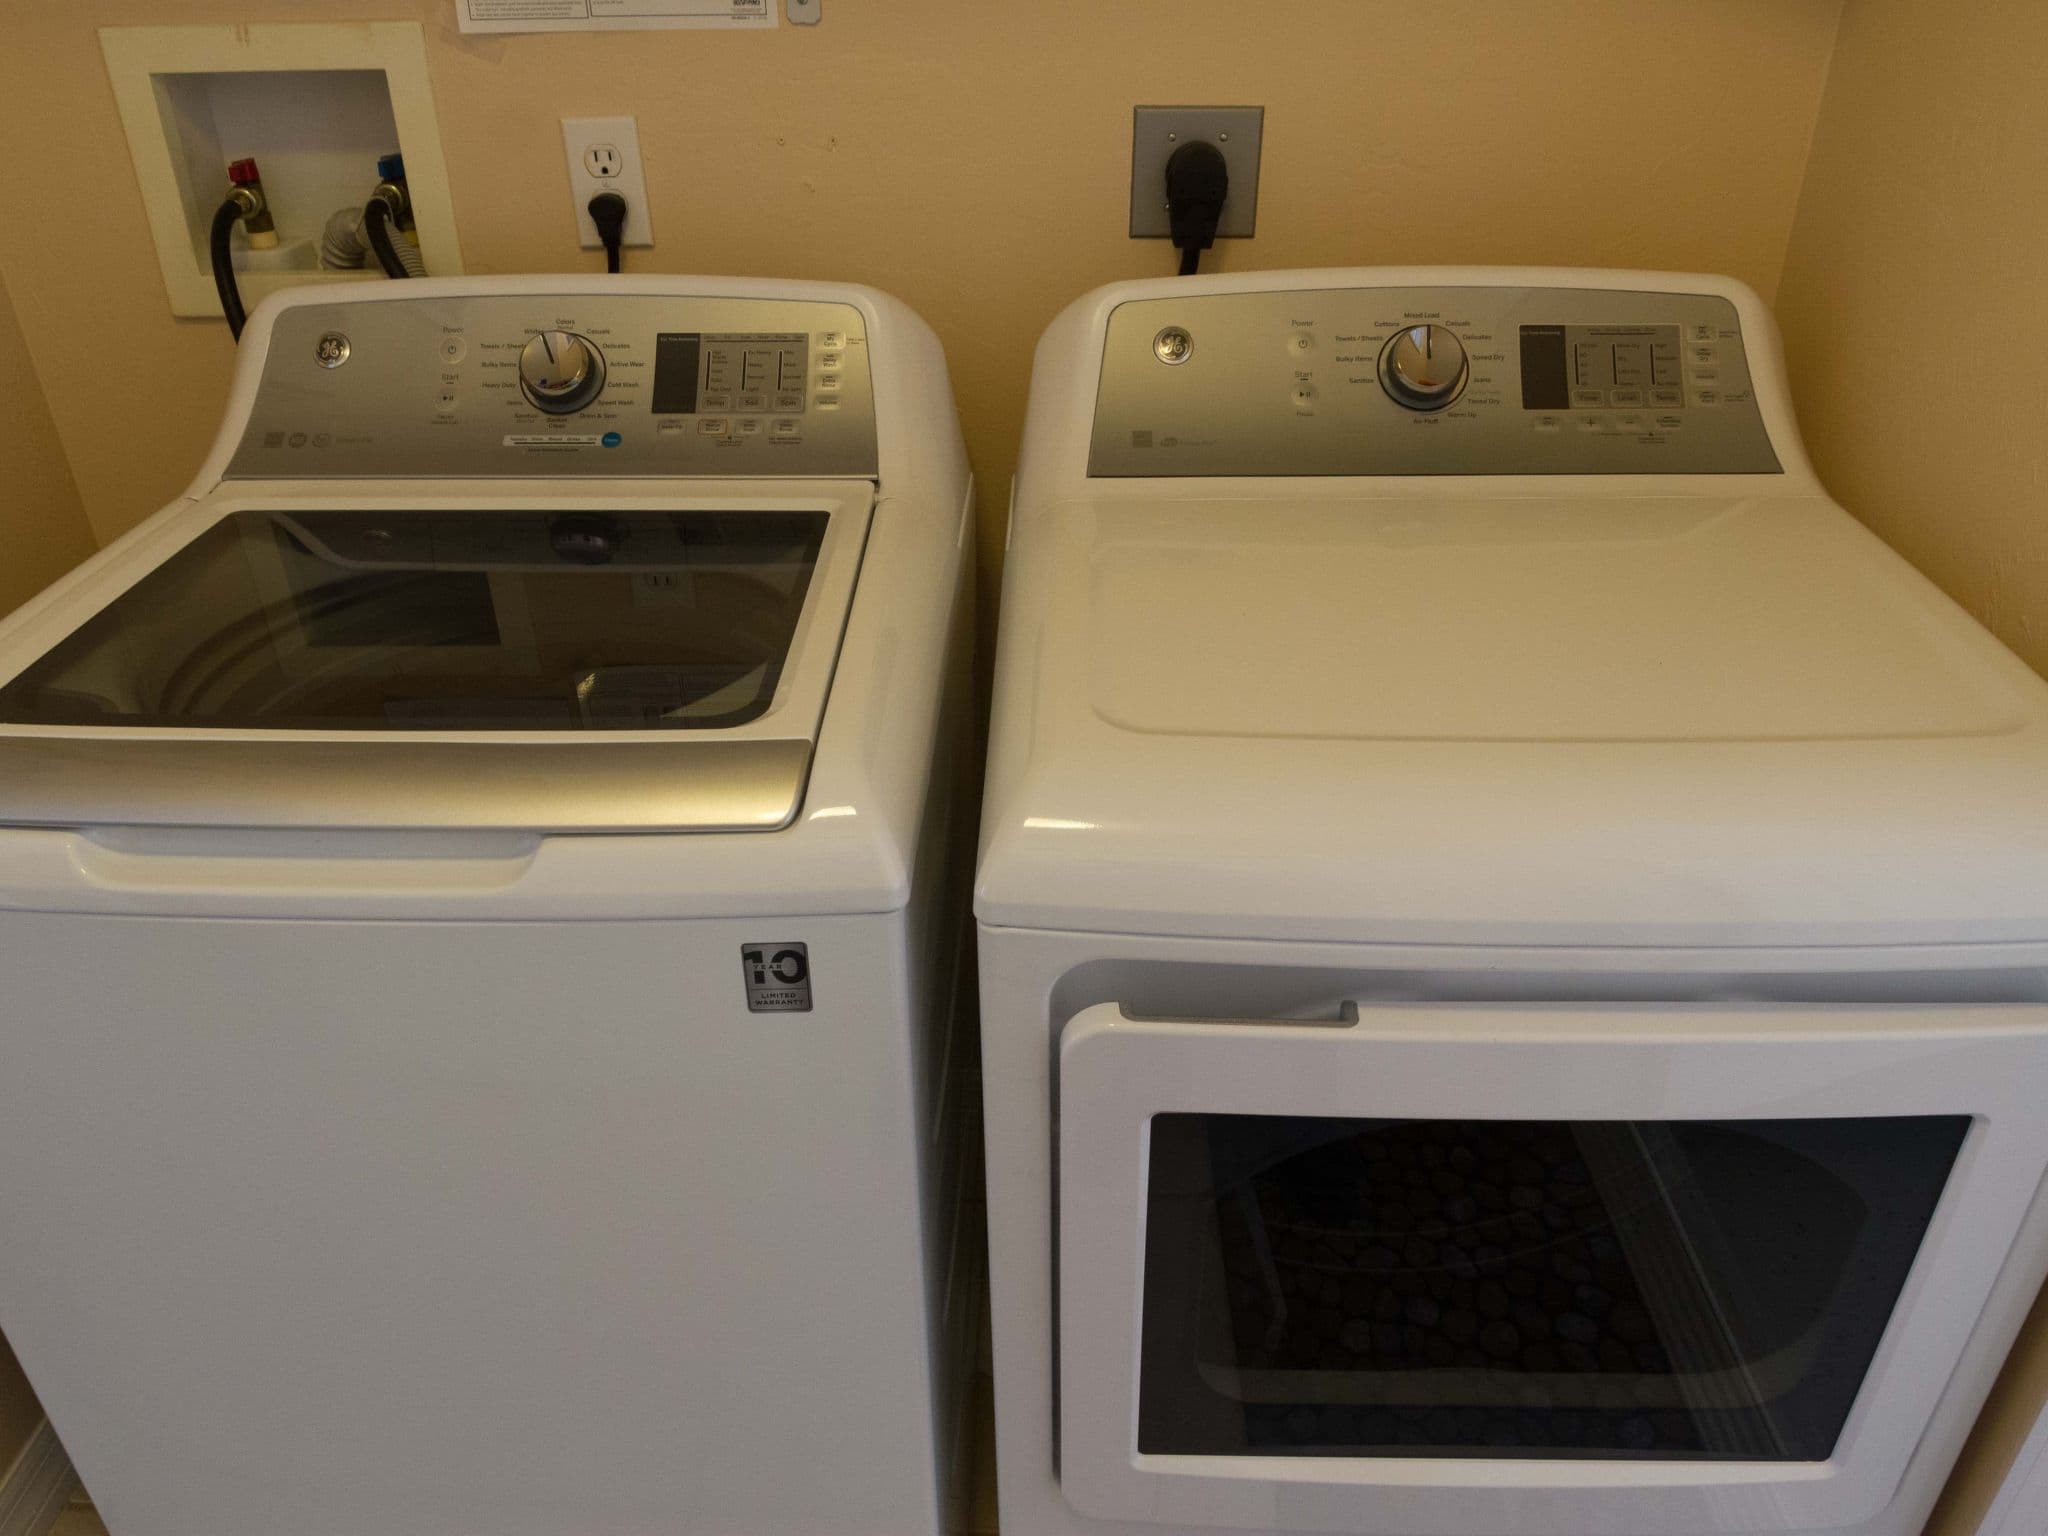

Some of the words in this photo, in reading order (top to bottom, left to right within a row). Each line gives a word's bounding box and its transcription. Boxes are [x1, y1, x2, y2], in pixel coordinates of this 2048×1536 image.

[1292, 319, 1313, 327] Power
[1295, 370, 1313, 378] Start
[744, 949, 807, 984] 10
